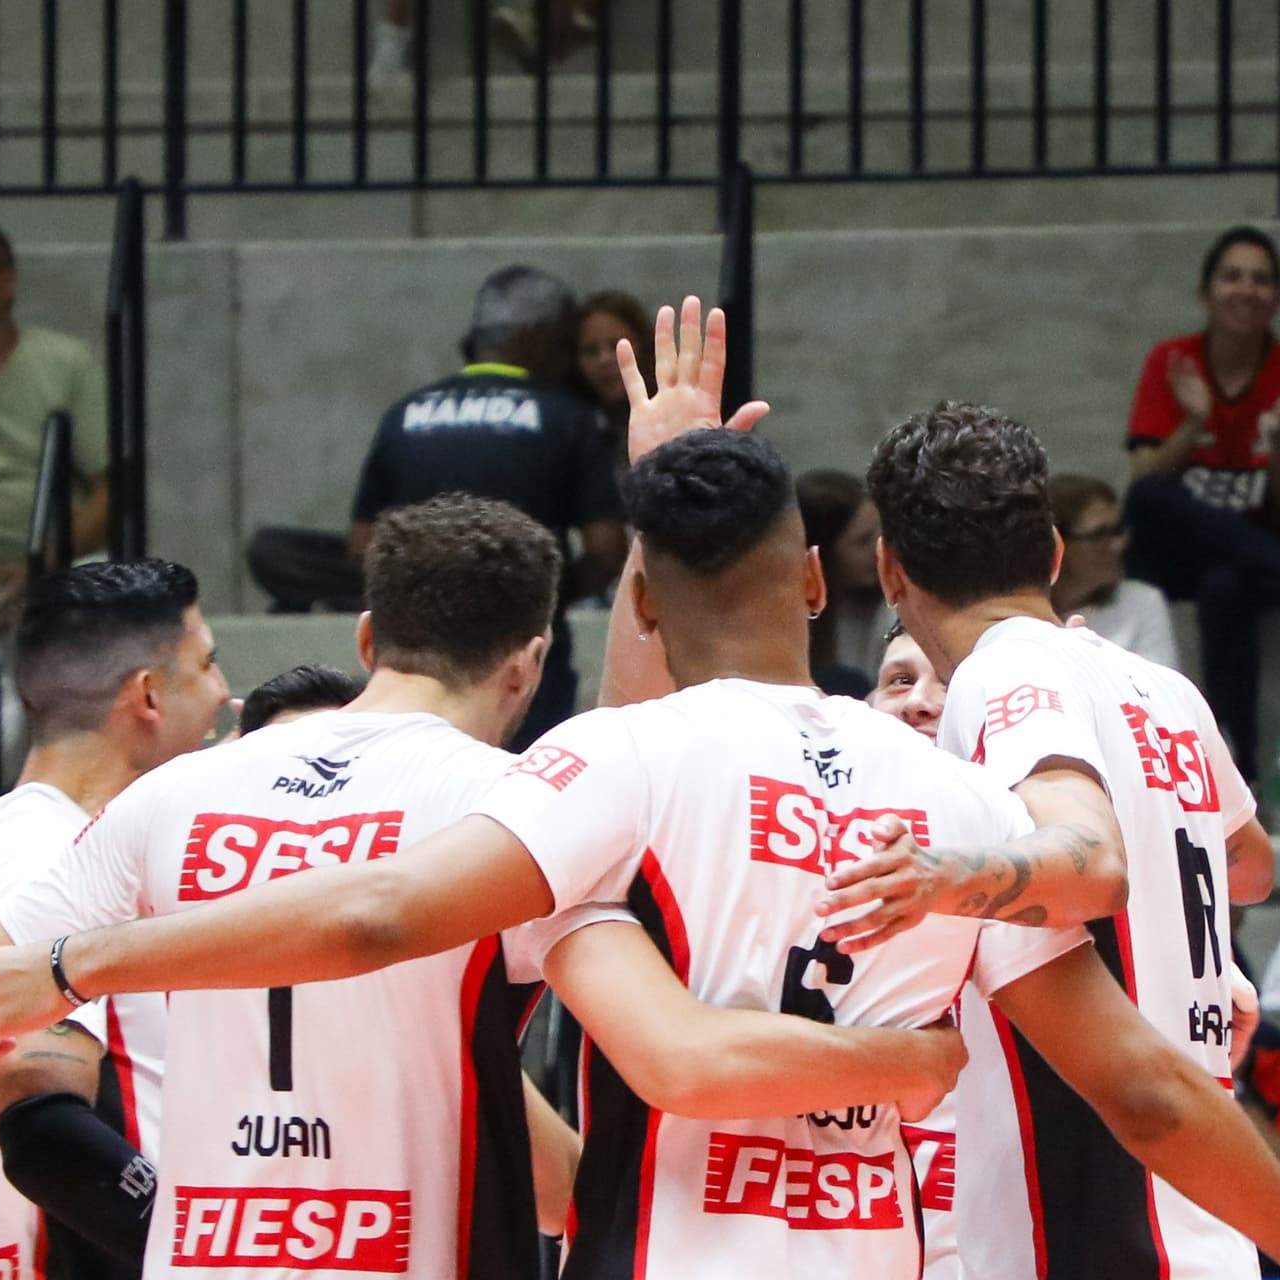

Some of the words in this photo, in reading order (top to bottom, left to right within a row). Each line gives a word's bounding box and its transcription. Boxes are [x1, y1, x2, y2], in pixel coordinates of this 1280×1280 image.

[402, 396, 542, 432] MANDA
[231, 1114, 332, 1160] JUAN
[181, 1198, 394, 1262] FIESP
